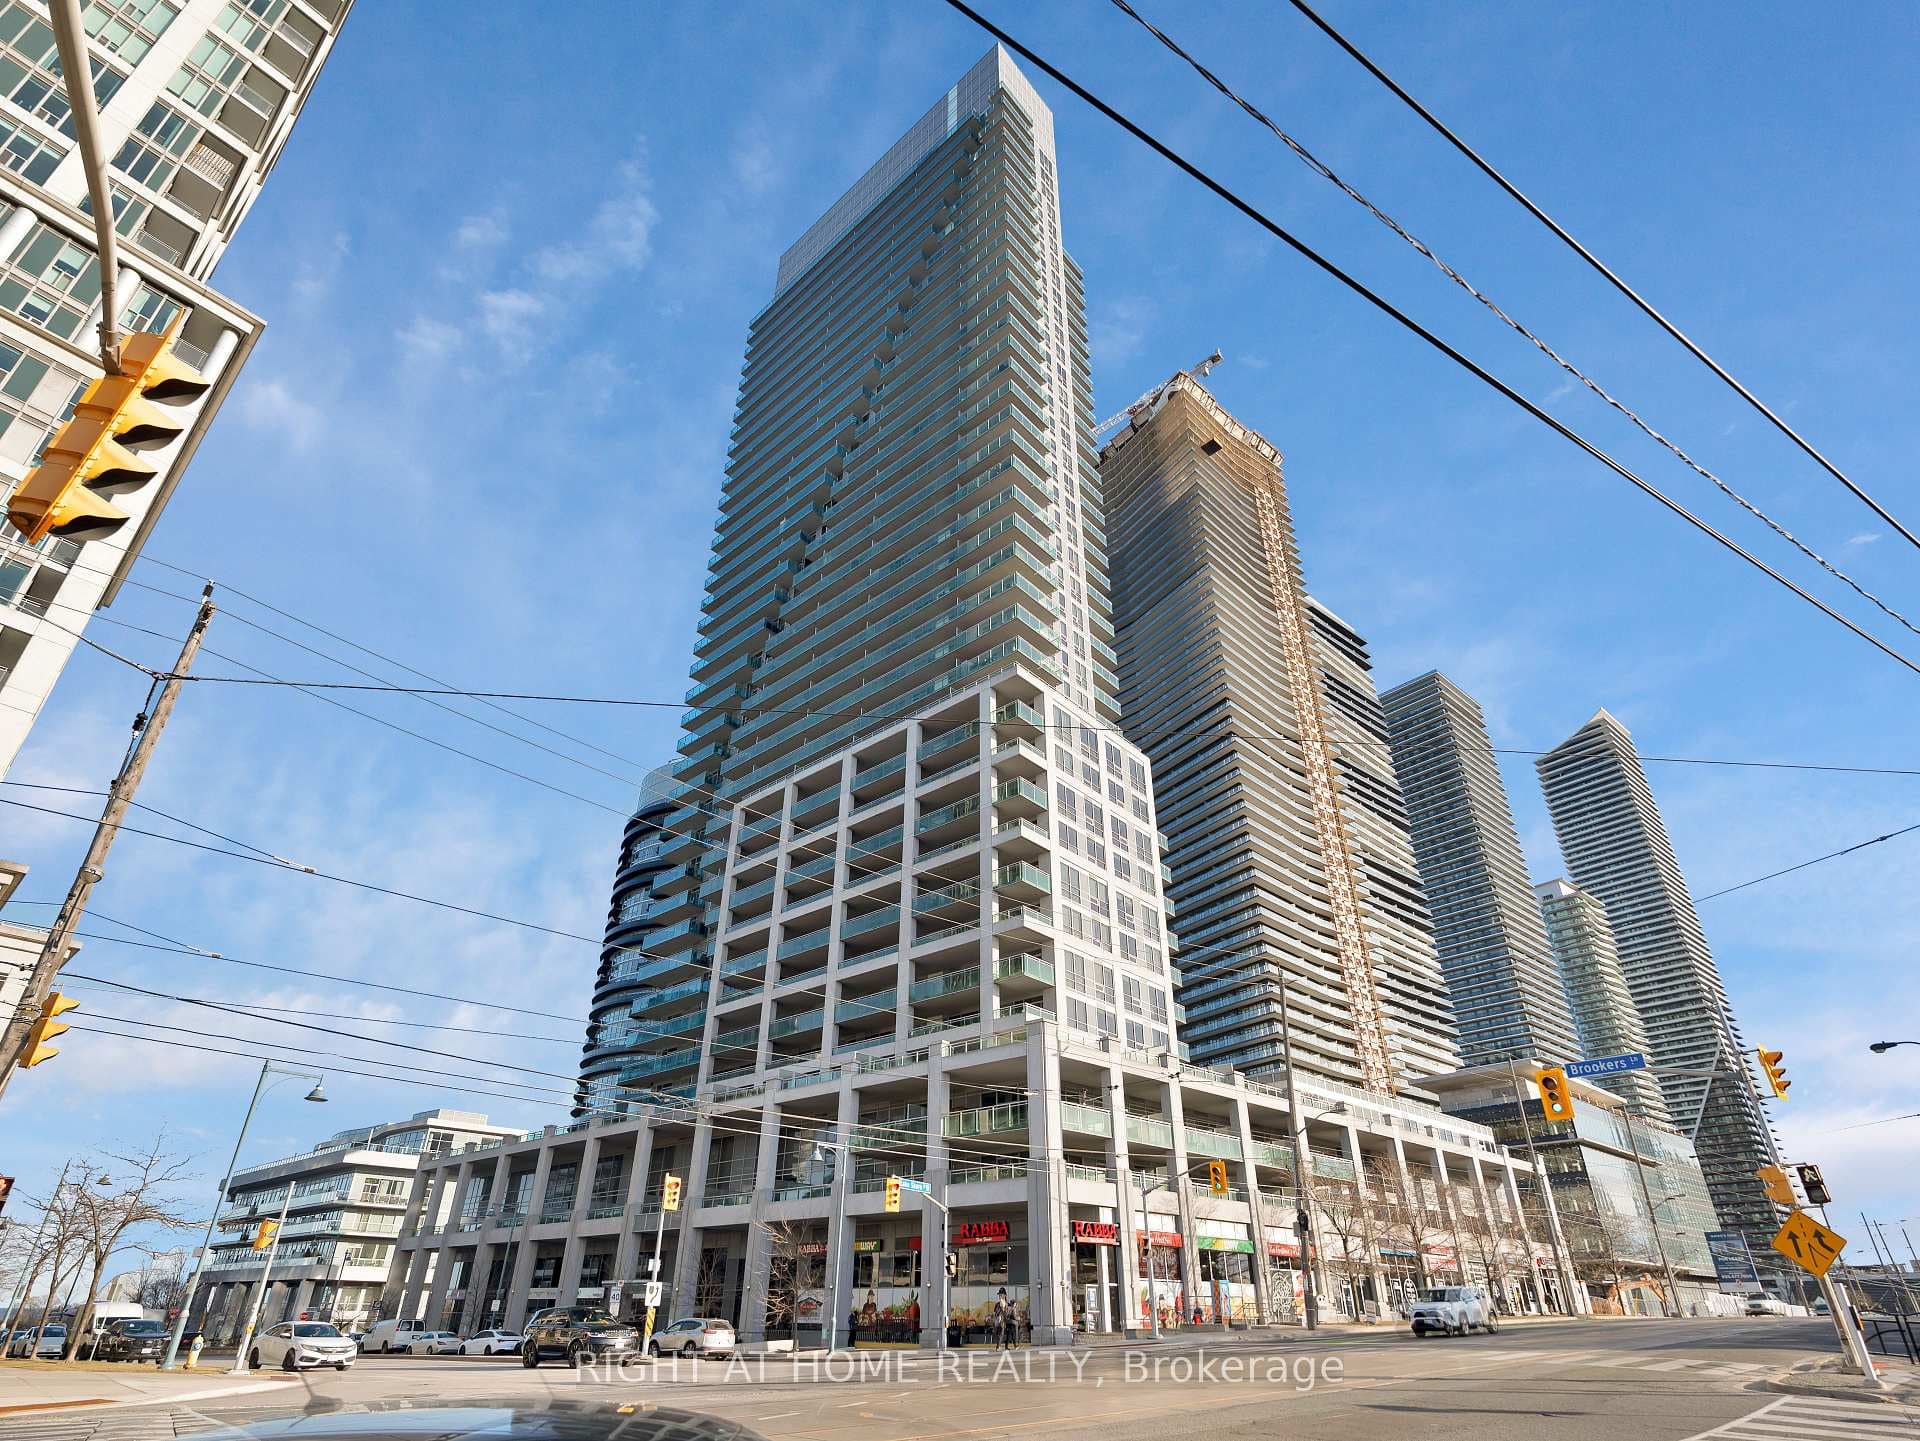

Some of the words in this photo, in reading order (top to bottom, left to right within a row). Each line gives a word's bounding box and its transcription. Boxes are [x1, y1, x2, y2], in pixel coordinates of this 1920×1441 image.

[1570, 1059, 1627, 1075] Brookers
[960, 1220, 1008, 1238] RABBA
[1075, 1221, 1117, 1238] RABBA
[611, 1293, 620, 1301] 40
